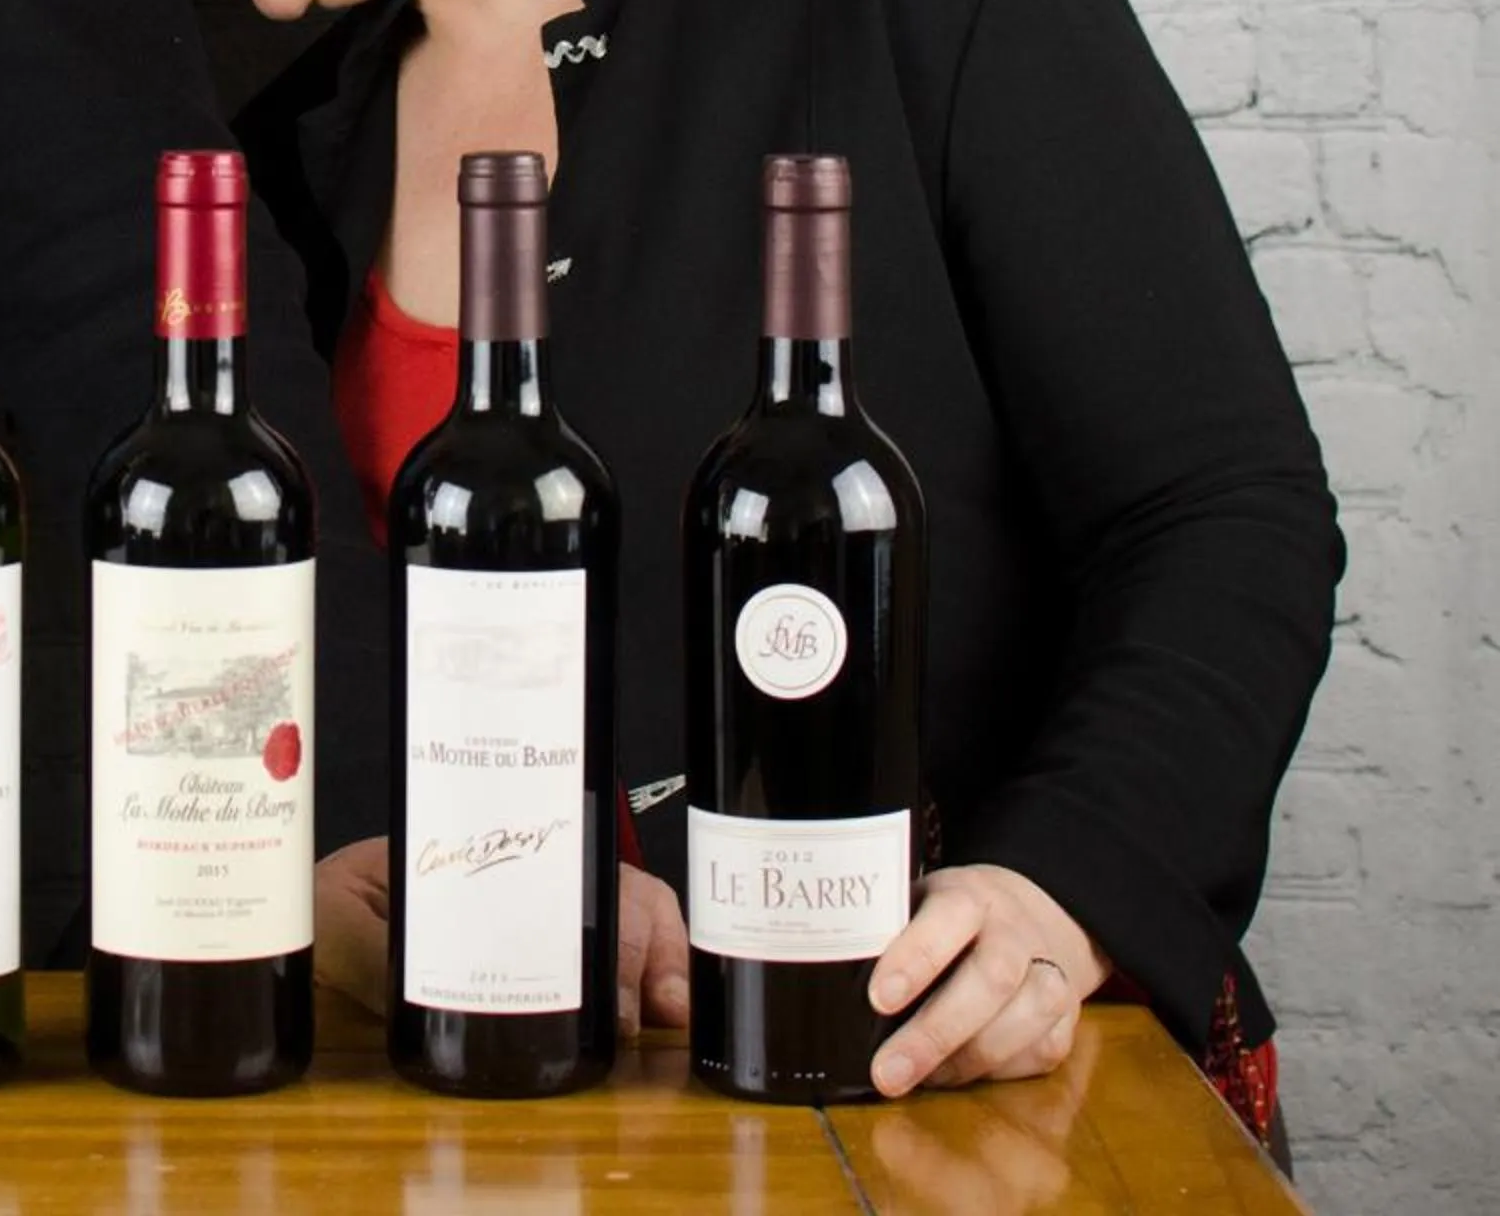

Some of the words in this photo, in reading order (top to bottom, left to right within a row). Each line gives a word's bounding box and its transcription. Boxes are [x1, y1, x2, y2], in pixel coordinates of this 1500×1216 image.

[215, 794, 239, 822] du
[710, 860, 747, 906] LE
[760, 867, 879, 910] BARRY
